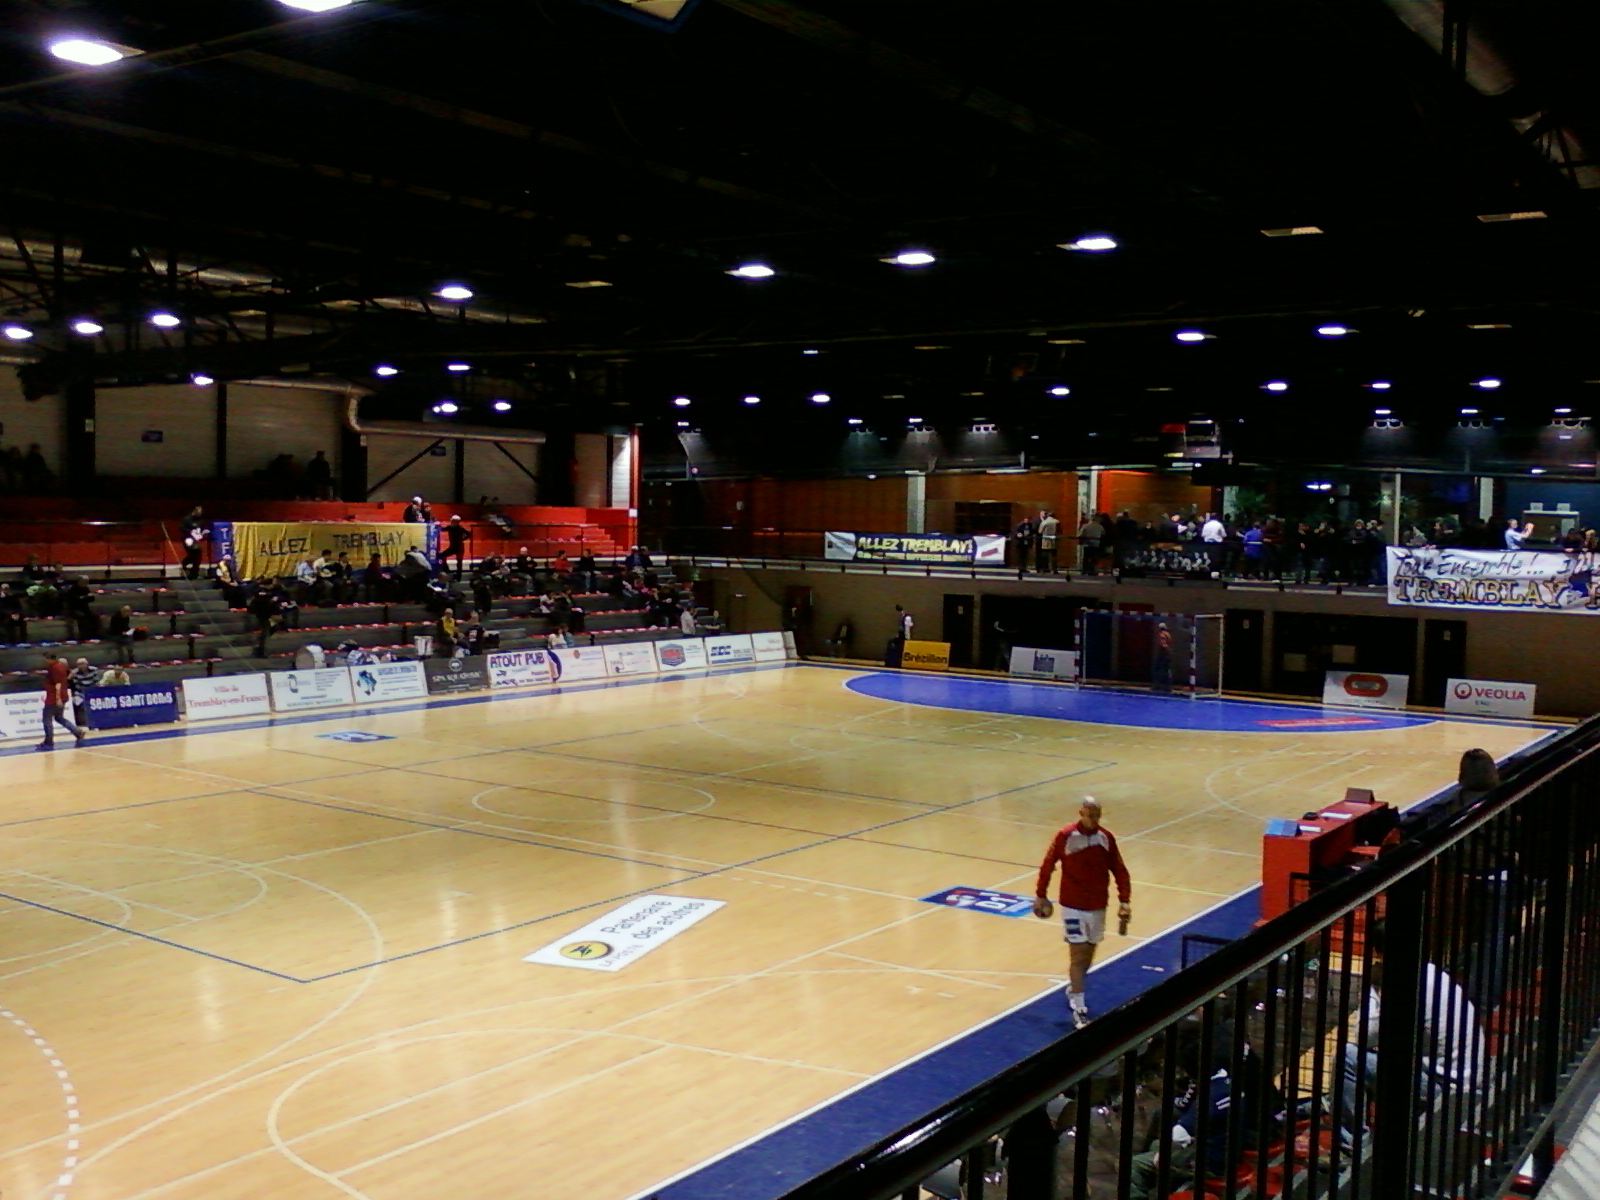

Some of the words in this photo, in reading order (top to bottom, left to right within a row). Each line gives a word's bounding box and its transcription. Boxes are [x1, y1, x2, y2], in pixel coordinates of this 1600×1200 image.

[260, 537, 308, 556] ALLEZ
[333, 531, 404, 549] TREMBLAY
[858, 537, 898, 550] ALLEZ
[901, 538, 973, 553] TREMBLAY!
[1393, 575, 1570, 609] TREMBLAY
[490, 656, 522, 669] ATOUT
[525, 652, 545, 665] PUB
[903, 652, 948, 664] Brézillon
[1475, 687, 1526, 701] VEOLIA
